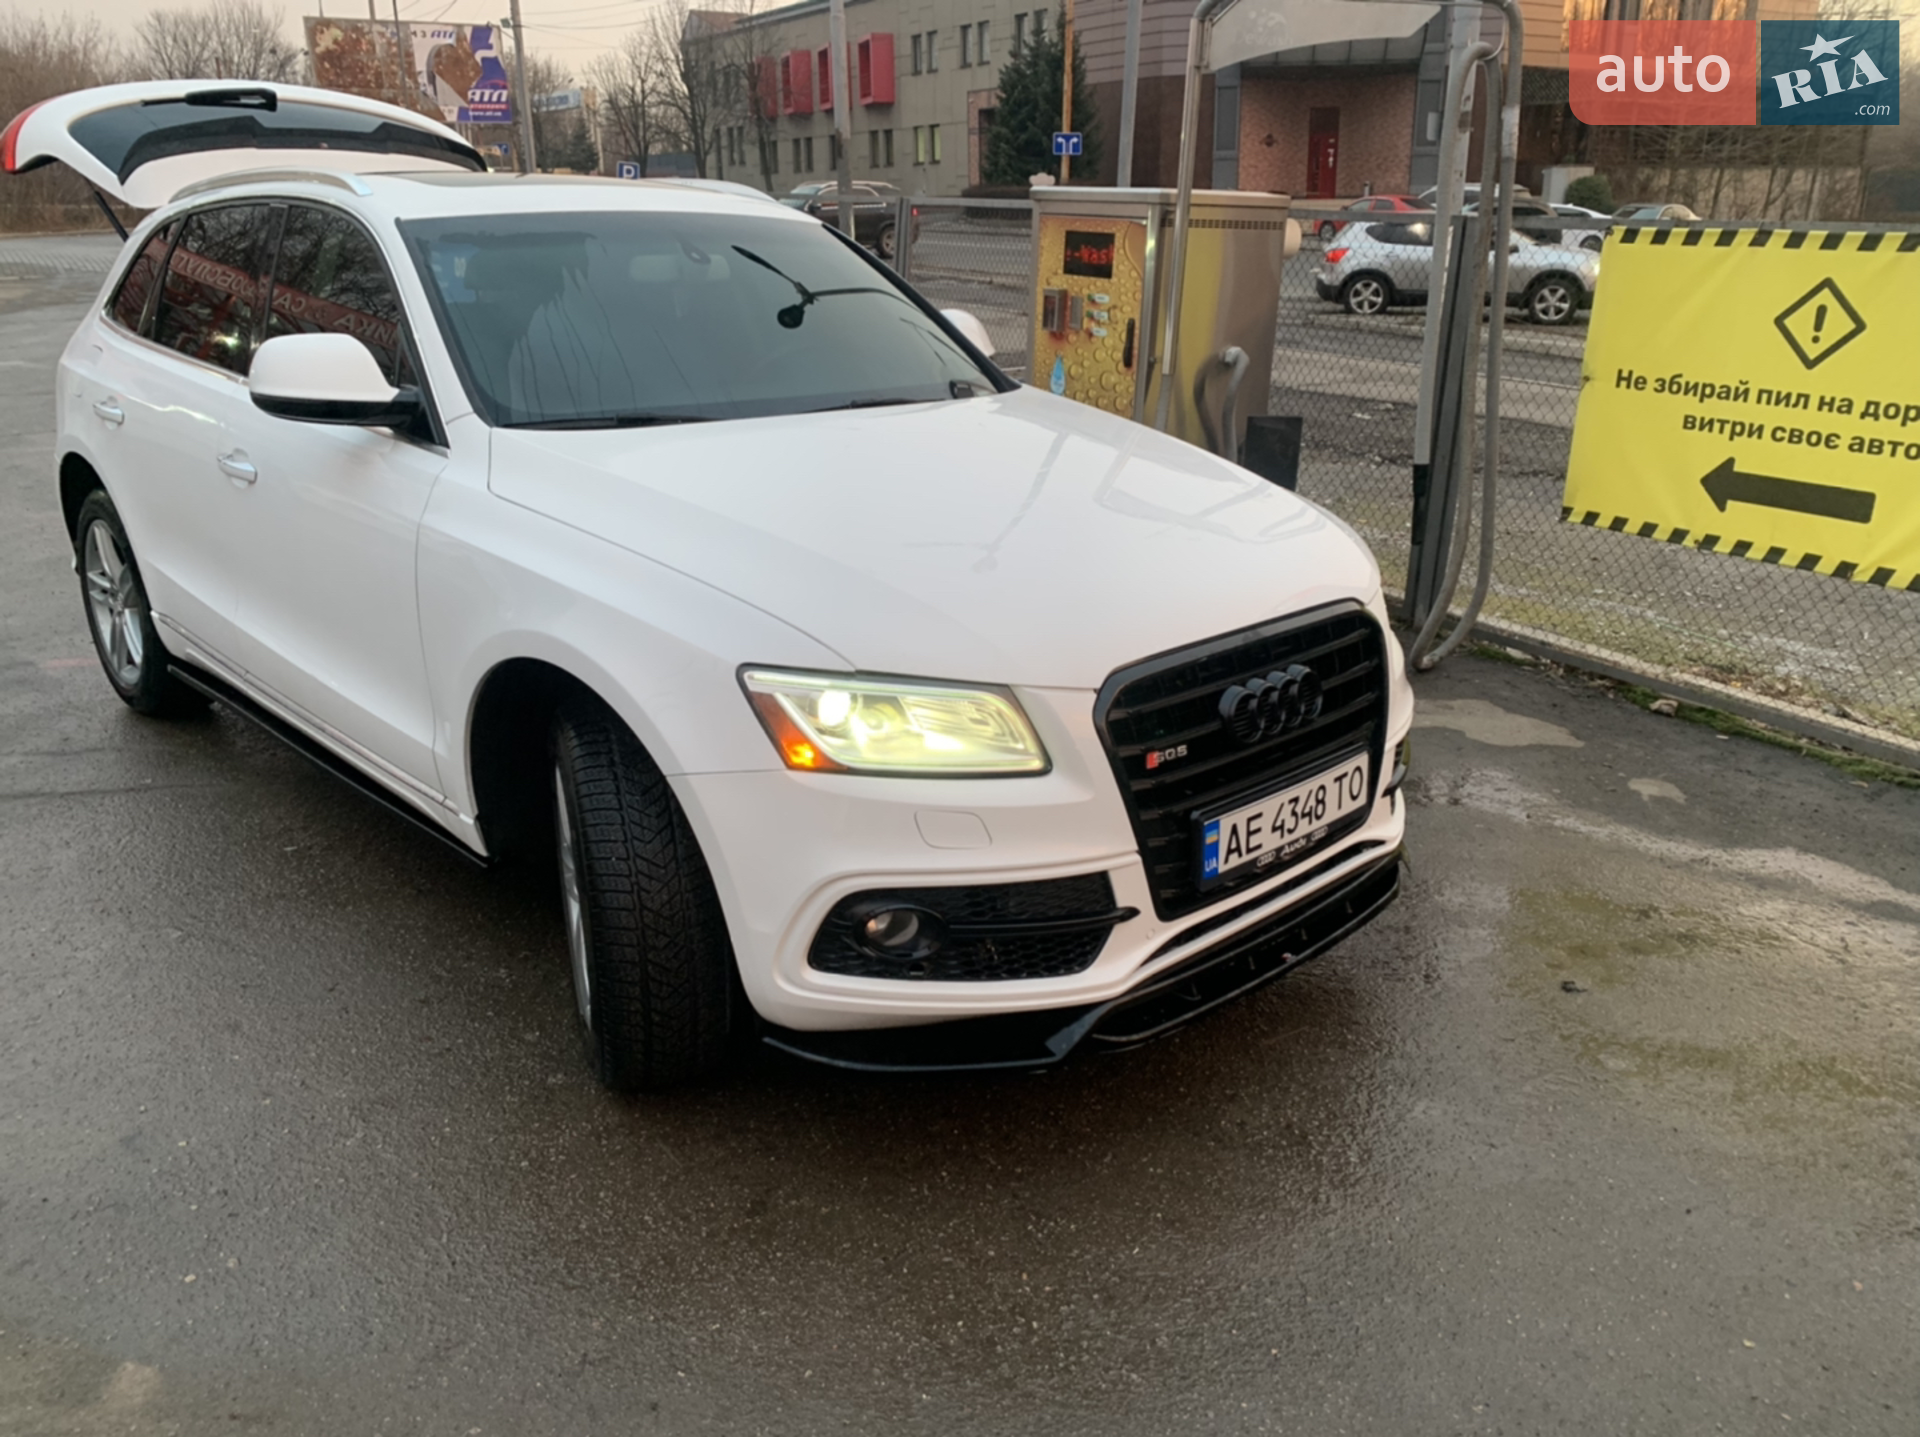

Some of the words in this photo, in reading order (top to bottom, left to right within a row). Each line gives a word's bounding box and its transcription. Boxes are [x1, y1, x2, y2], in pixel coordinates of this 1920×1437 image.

[1615, 369, 1648, 391] Не
[1653, 373, 1750, 404] збирай
[1757, 388, 1811, 411] пил
[1817, 394, 1854, 416] на
[1860, 400, 1920, 427] дор
[1682, 413, 1765, 442] витри
[1770, 424, 1842, 450] своє
[1848, 435, 1920, 461] авто
[1223, 812, 1264, 866] AE
[1271, 784, 1328, 840] 4348
[1333, 765, 1365, 811] TO
[1204, 857, 1218, 873] UA
